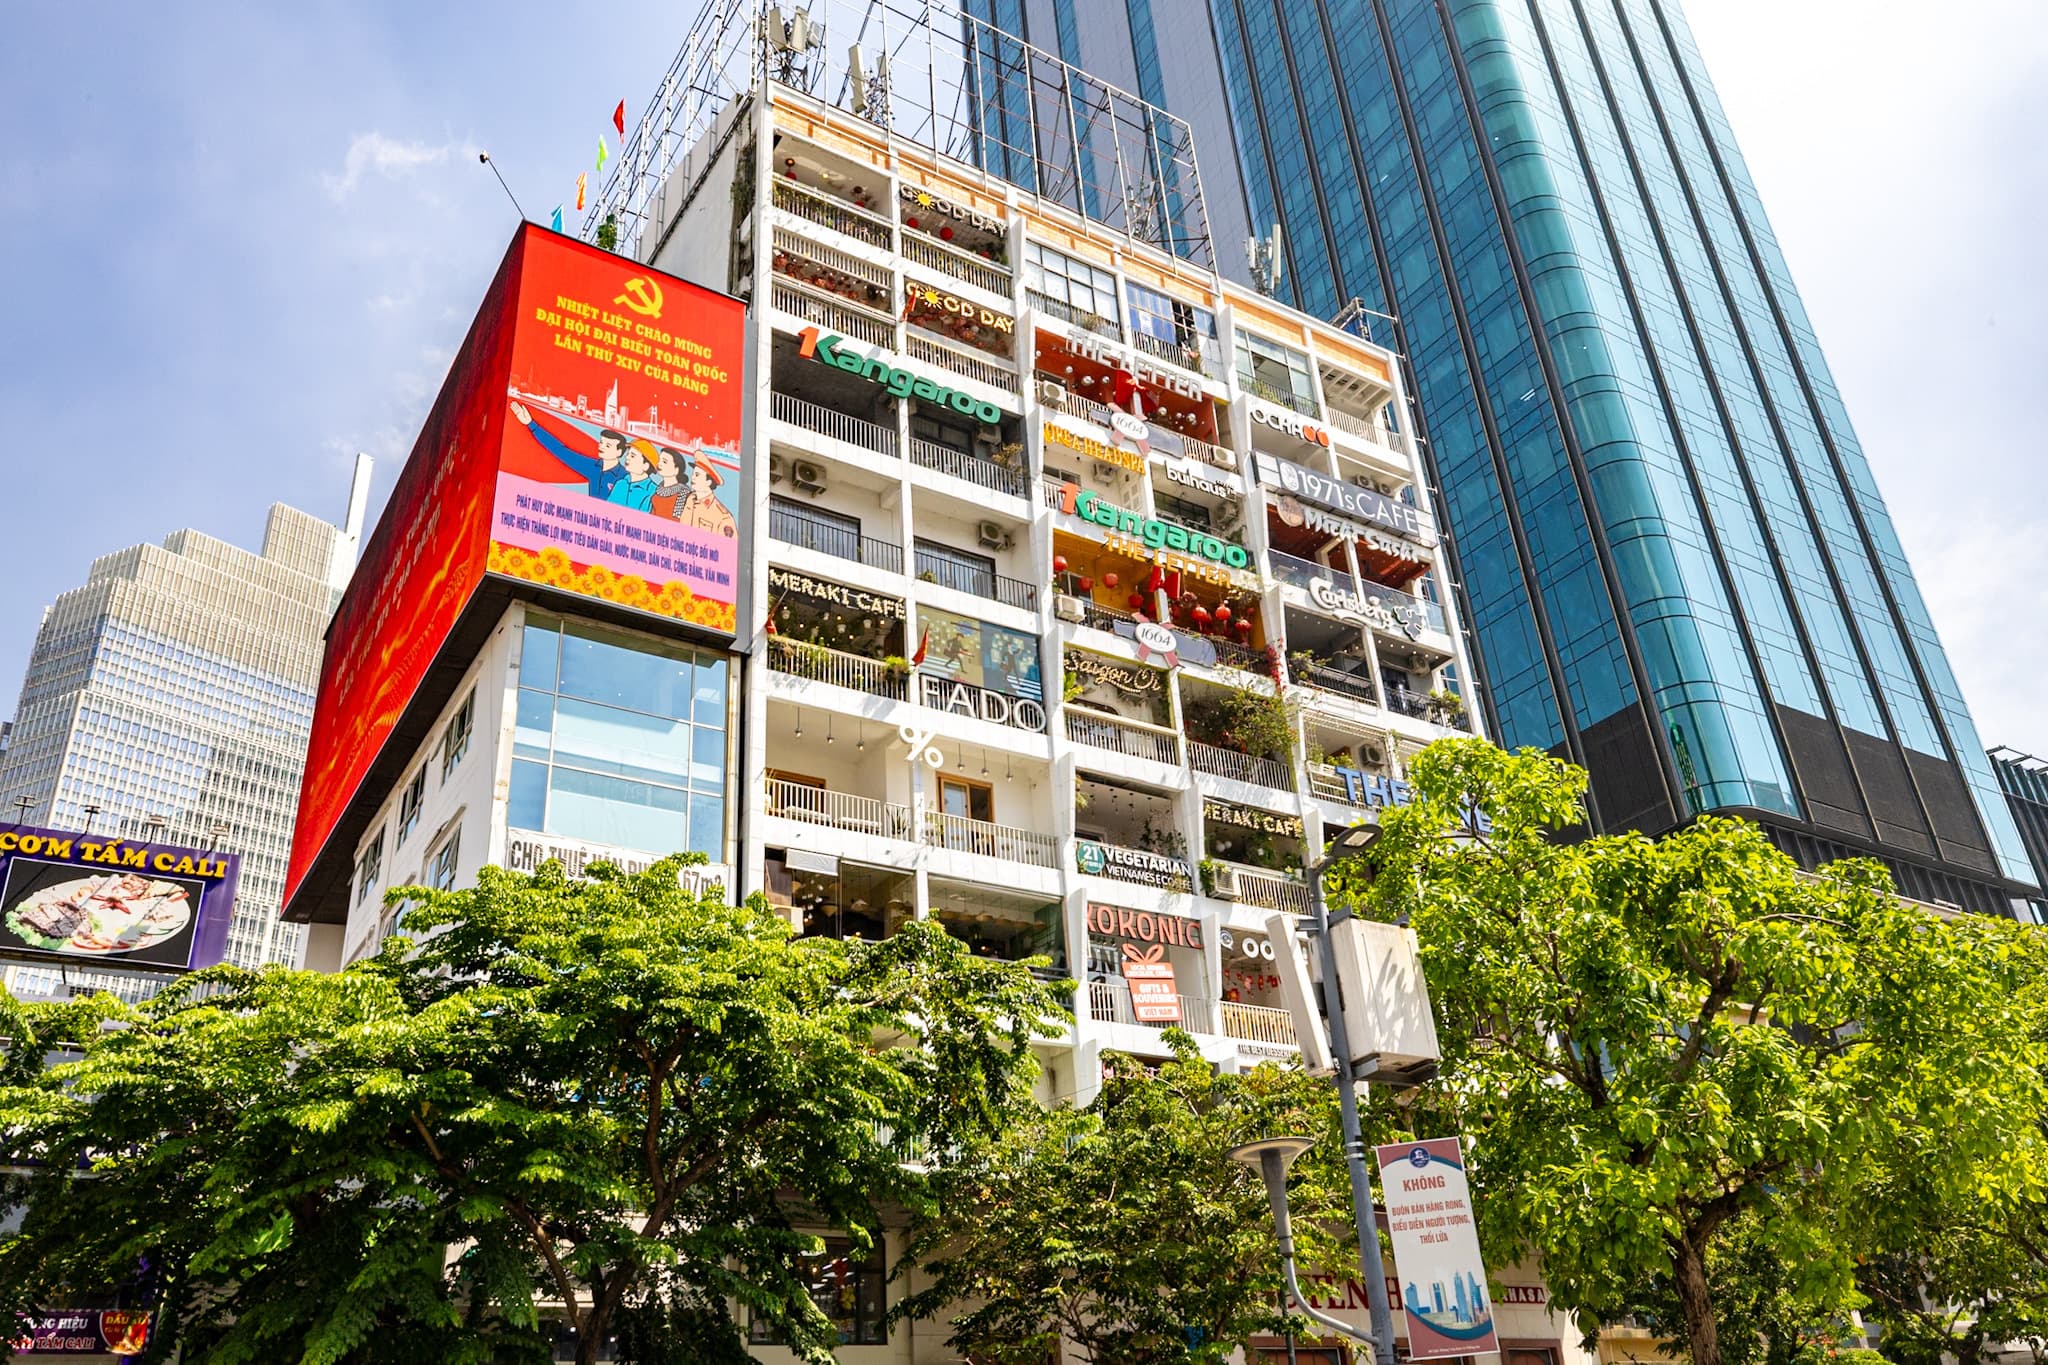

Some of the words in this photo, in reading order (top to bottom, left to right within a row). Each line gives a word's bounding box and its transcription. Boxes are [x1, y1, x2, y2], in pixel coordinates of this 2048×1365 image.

[970, 213, 1008, 238] DAY
[556, 295, 600, 320] NHIỆT
[602, 311, 632, 331] LIỆT
[635, 323, 671, 345] CHÀO
[674, 336, 712, 359] MỪNG
[979, 308, 1015, 334] DAY
[536, 307, 561, 327] ĐẠI
[565, 317, 590, 337] HỘI
[593, 326, 618, 345] ĐẠI
[620, 336, 652, 357] BIỂU
[655, 348, 690, 371] TOÀN
[693, 362, 728, 383] QUỐC
[1066, 327, 1114, 368] THE
[1119, 350, 1203, 403] LETTER
[615, 353, 641, 372] XIV
[644, 364, 670, 383] CỦA
[673, 374, 709, 396] ĐẢNG
[1165, 460, 1226, 498] buihaus
[1298, 469, 1354, 511] 1971's
[1356, 493, 1419, 534] CAFE
[1104, 531, 1148, 563] THE
[1152, 548, 1231, 589] LETTER
[769, 569, 850, 607] MERAKI
[856, 593, 906, 620] CAFÉ
[1309, 576, 1393, 628] Carlsberg
[1063, 650, 1133, 684] Saigon
[921, 675, 1047, 733] FADO
[1335, 766, 1410, 807] THE
[0, 831, 73, 858] CƠM
[79, 838, 150, 868] TẤM
[153, 853, 228, 878] CALI
[1083, 845, 1098, 861] 21
[1104, 847, 1192, 876] VEGETARIAN
[1402, 1175, 1446, 1192] KHÔNG
[1392, 1204, 1410, 1216] BUÔN
[36, 1331, 65, 1349] TẤM
[65, 1337, 96, 1350] CALI
[57, 1315, 88, 1332] HIỆU
